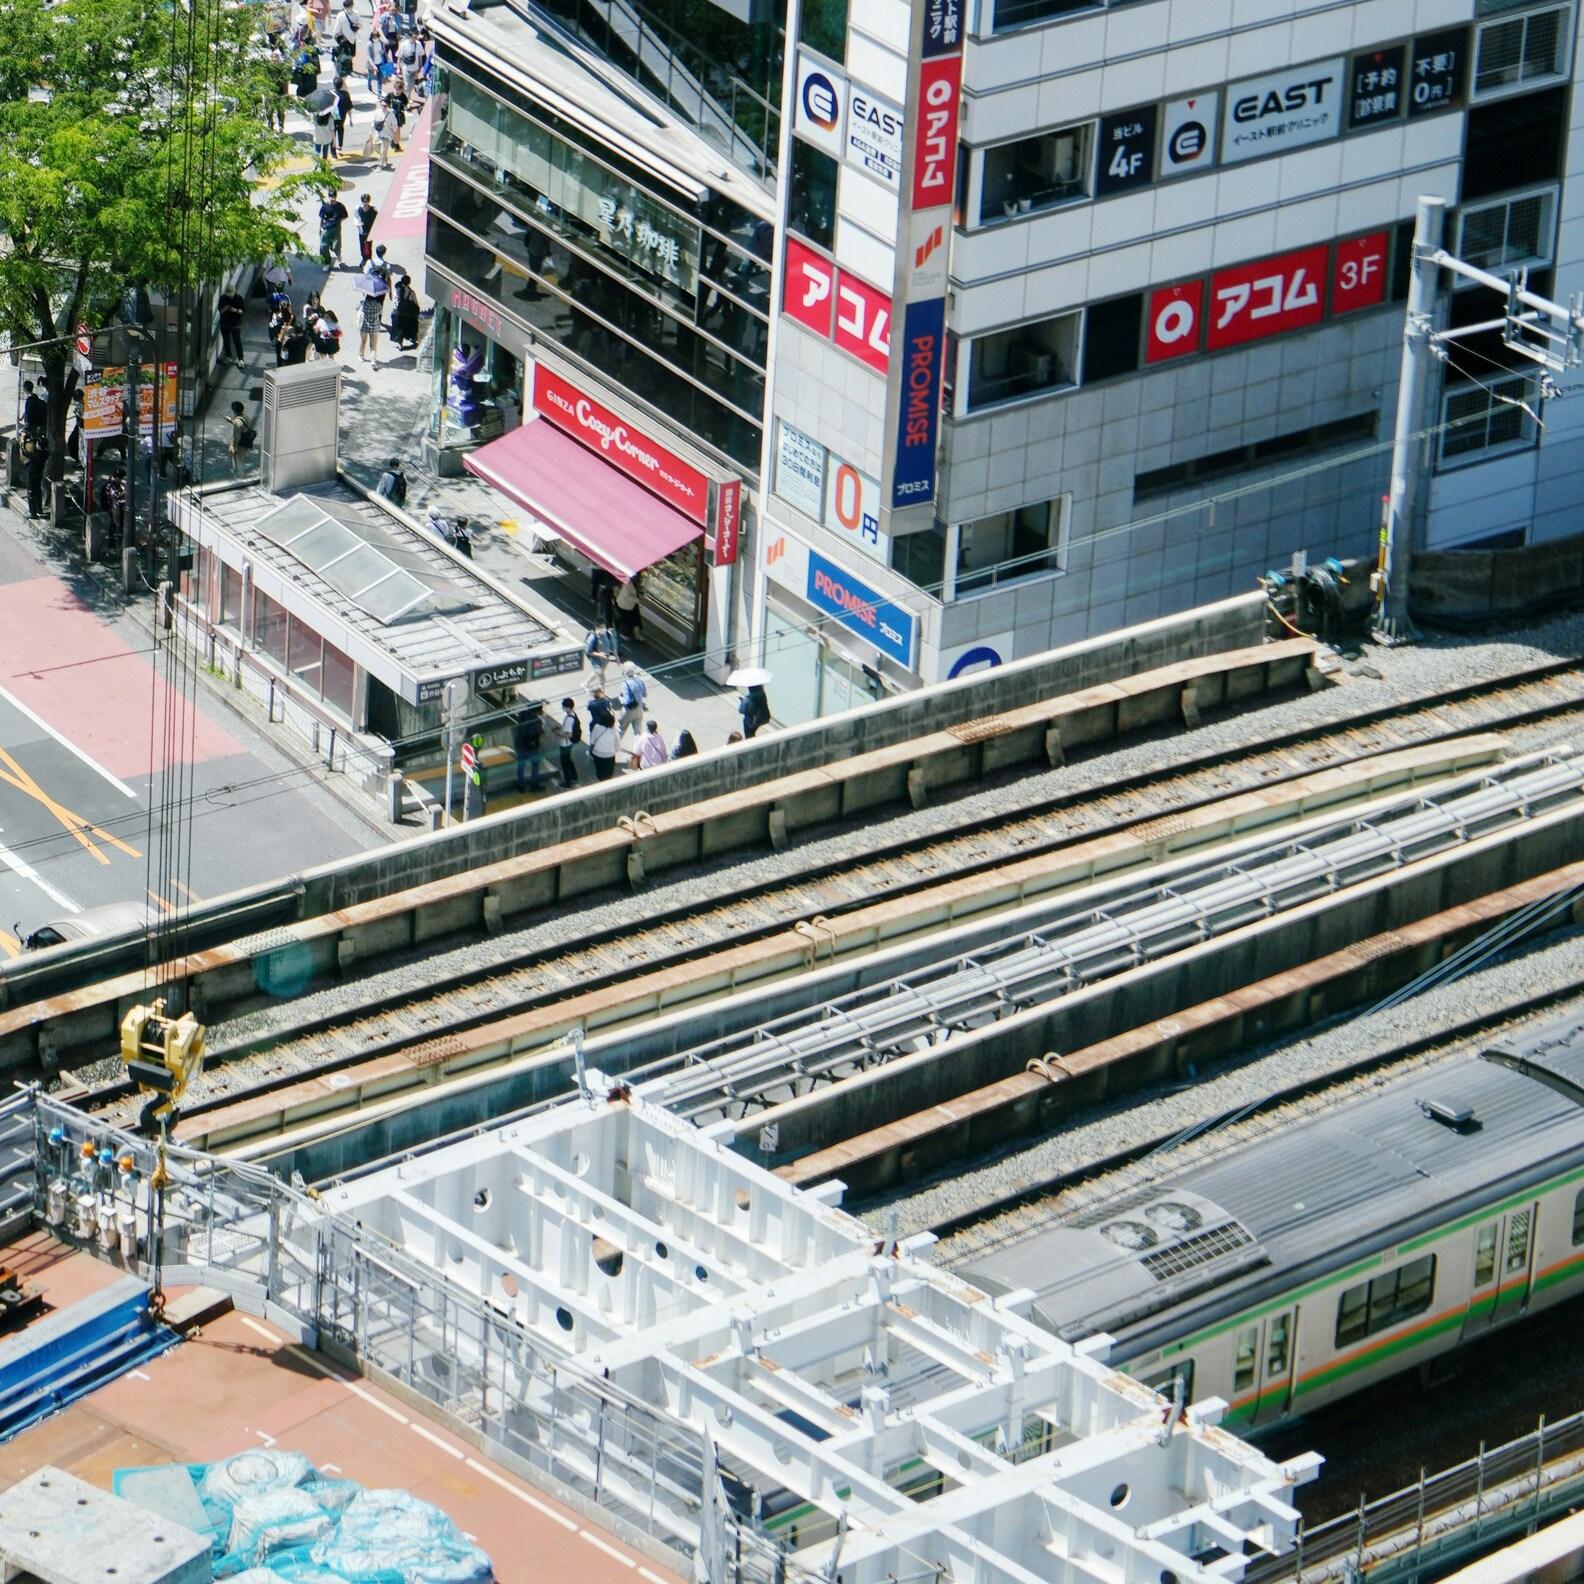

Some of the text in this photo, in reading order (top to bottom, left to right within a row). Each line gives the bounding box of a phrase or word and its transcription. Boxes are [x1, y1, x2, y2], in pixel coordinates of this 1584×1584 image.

[1233, 76, 1334, 124] EAST
[921, 112, 949, 188] アコム
[1112, 123, 1144, 142] 当ビル
[1232, 112, 1330, 146] イースト駅前クリニック
[1108, 149, 1143, 179] 4F
[1215, 253, 1382, 331] アコム 3F
[546, 388, 576, 419] GINZA
[905, 335, 934, 448] PROMISE
[834, 462, 879, 545] 0 円
[896, 479, 931, 496] プロミス
[814, 569, 877, 629] PROMISE
